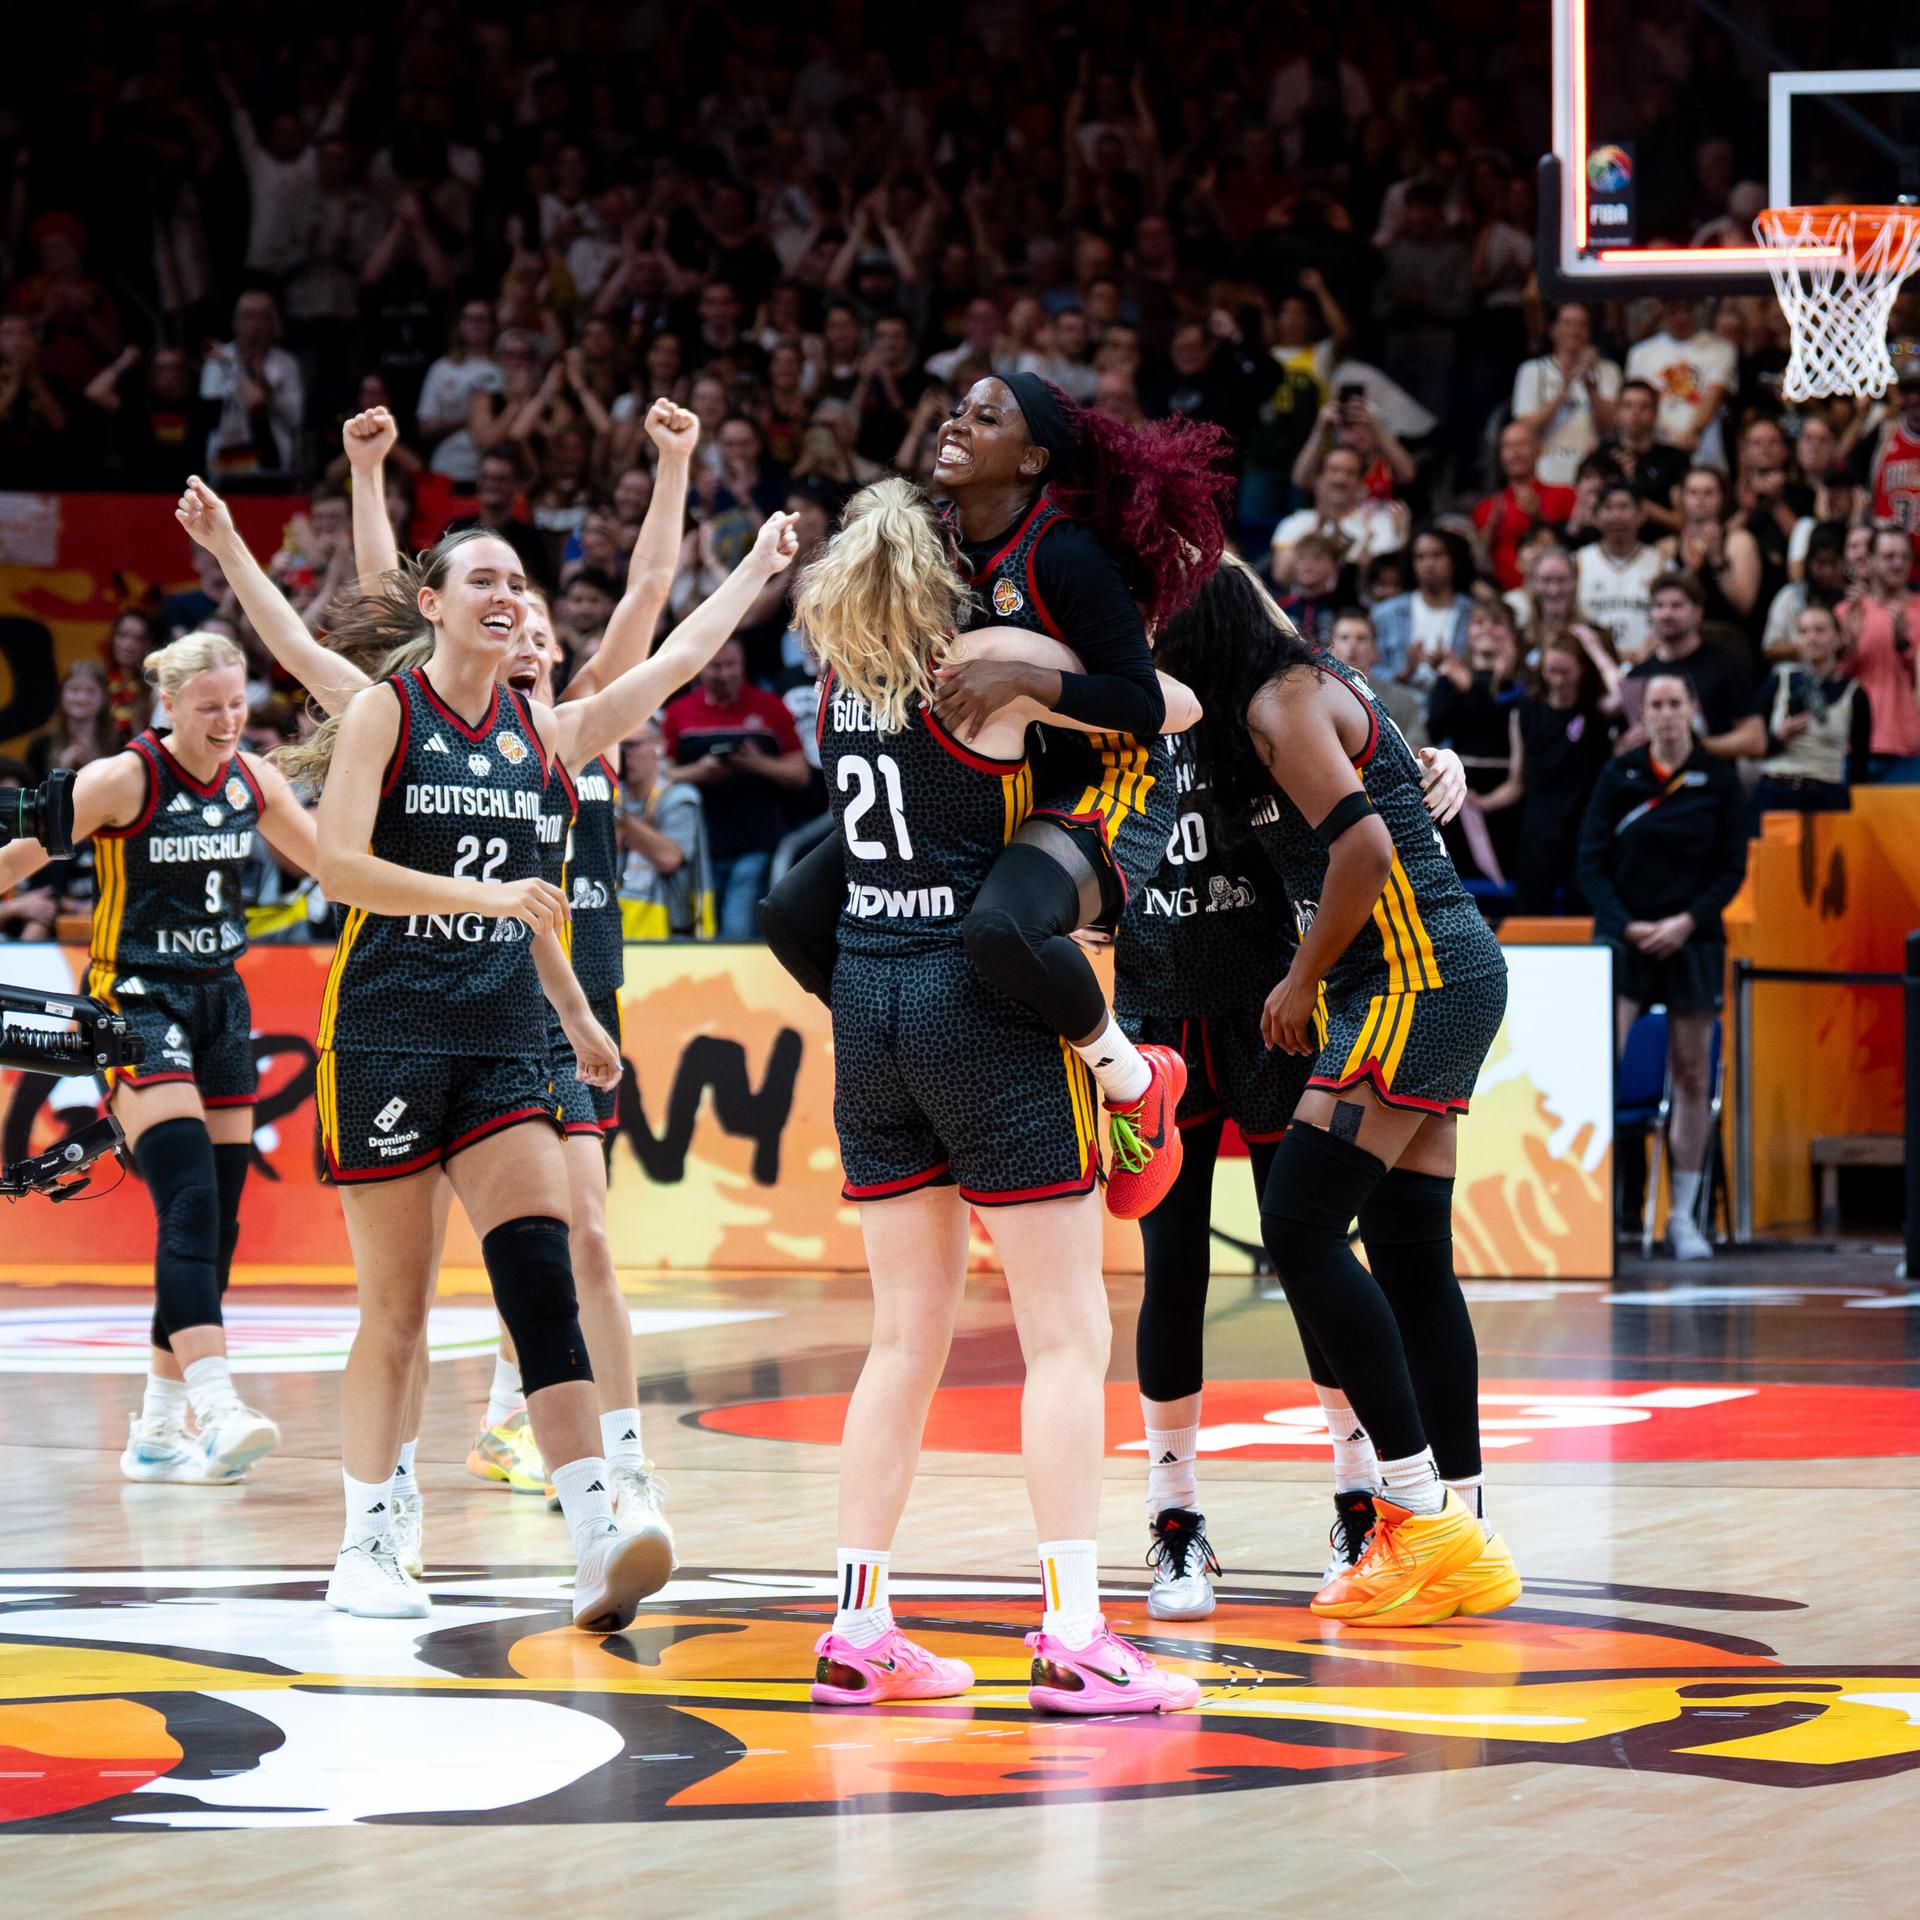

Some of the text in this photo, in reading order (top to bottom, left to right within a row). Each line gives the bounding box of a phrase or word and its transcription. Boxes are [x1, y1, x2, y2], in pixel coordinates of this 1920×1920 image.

[1589, 203, 1628, 226] FIBA
[837, 754, 914, 861] 21
[453, 835, 508, 884] 22
[205, 870, 224, 914] 9
[1143, 887, 1199, 917] ING
[155, 927, 218, 954] ING
[404, 912, 486, 943] ING
[368, 1130, 420, 1148] Domino's
[380, 1144, 410, 1158] Pizza
